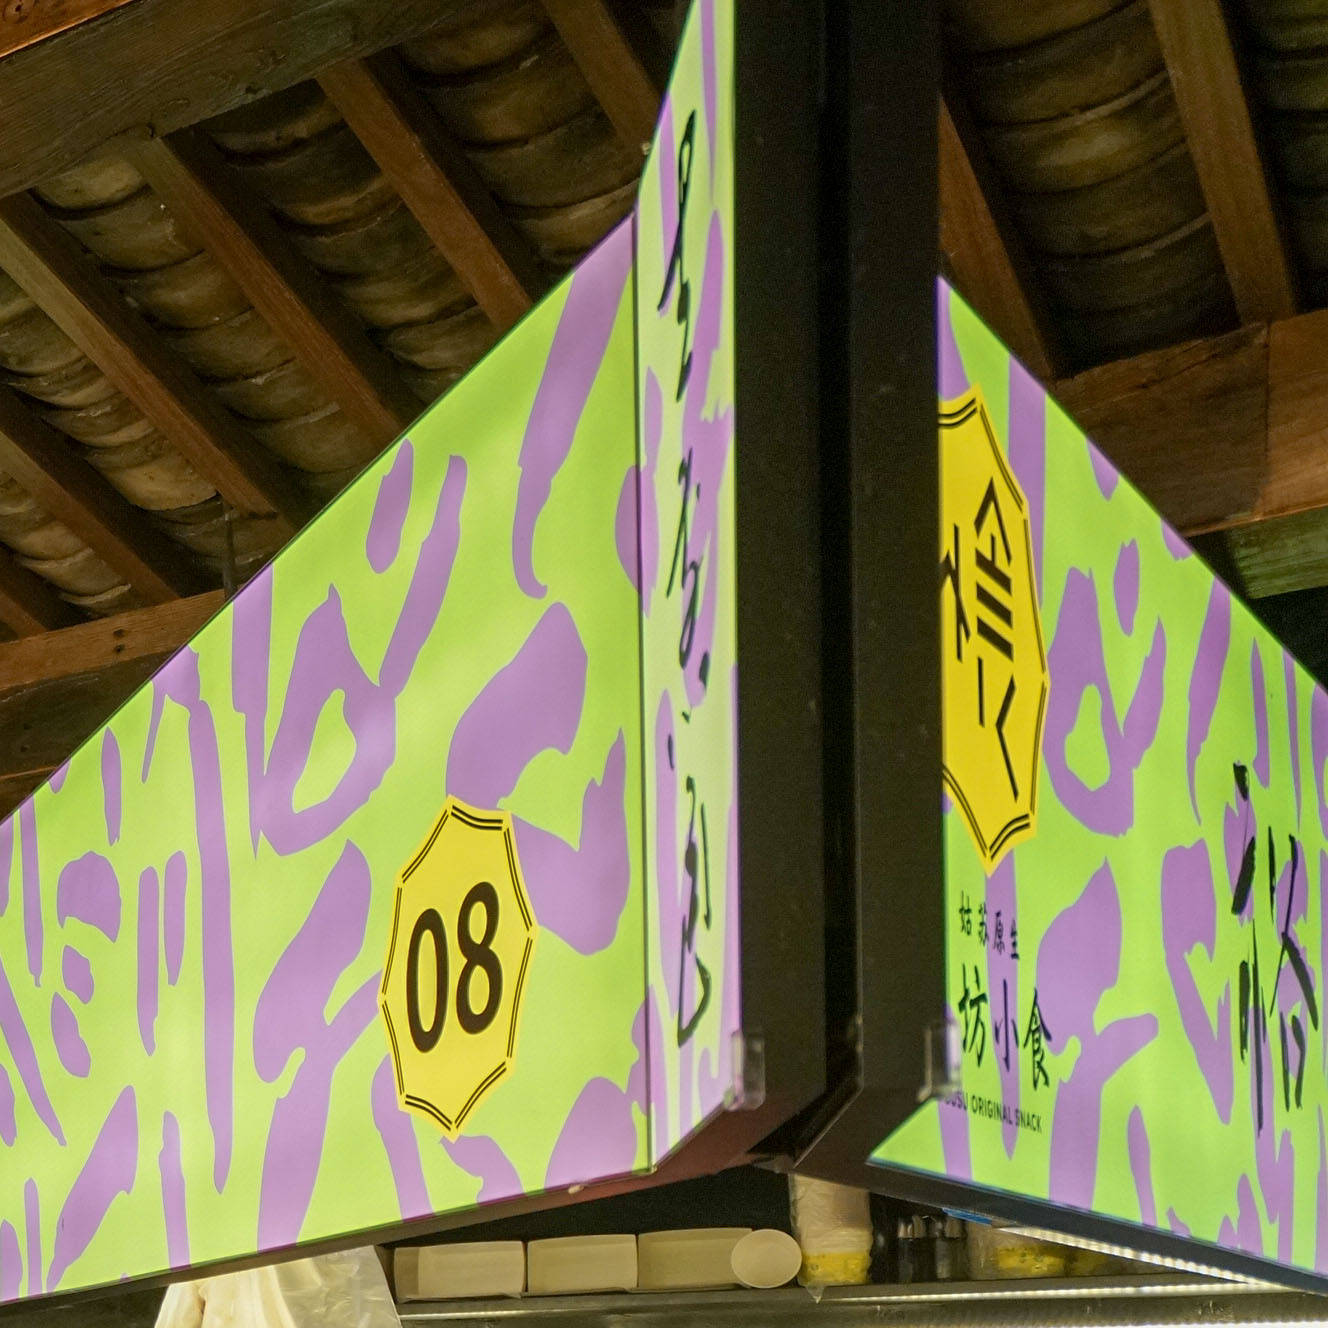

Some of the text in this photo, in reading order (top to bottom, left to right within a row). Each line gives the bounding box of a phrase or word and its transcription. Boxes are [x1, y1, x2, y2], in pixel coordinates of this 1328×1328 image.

[406, 882, 503, 1055] 08
[971, 1094, 1013, 1125] ORIGINAL
[1015, 1107, 1042, 1133] SNACK
